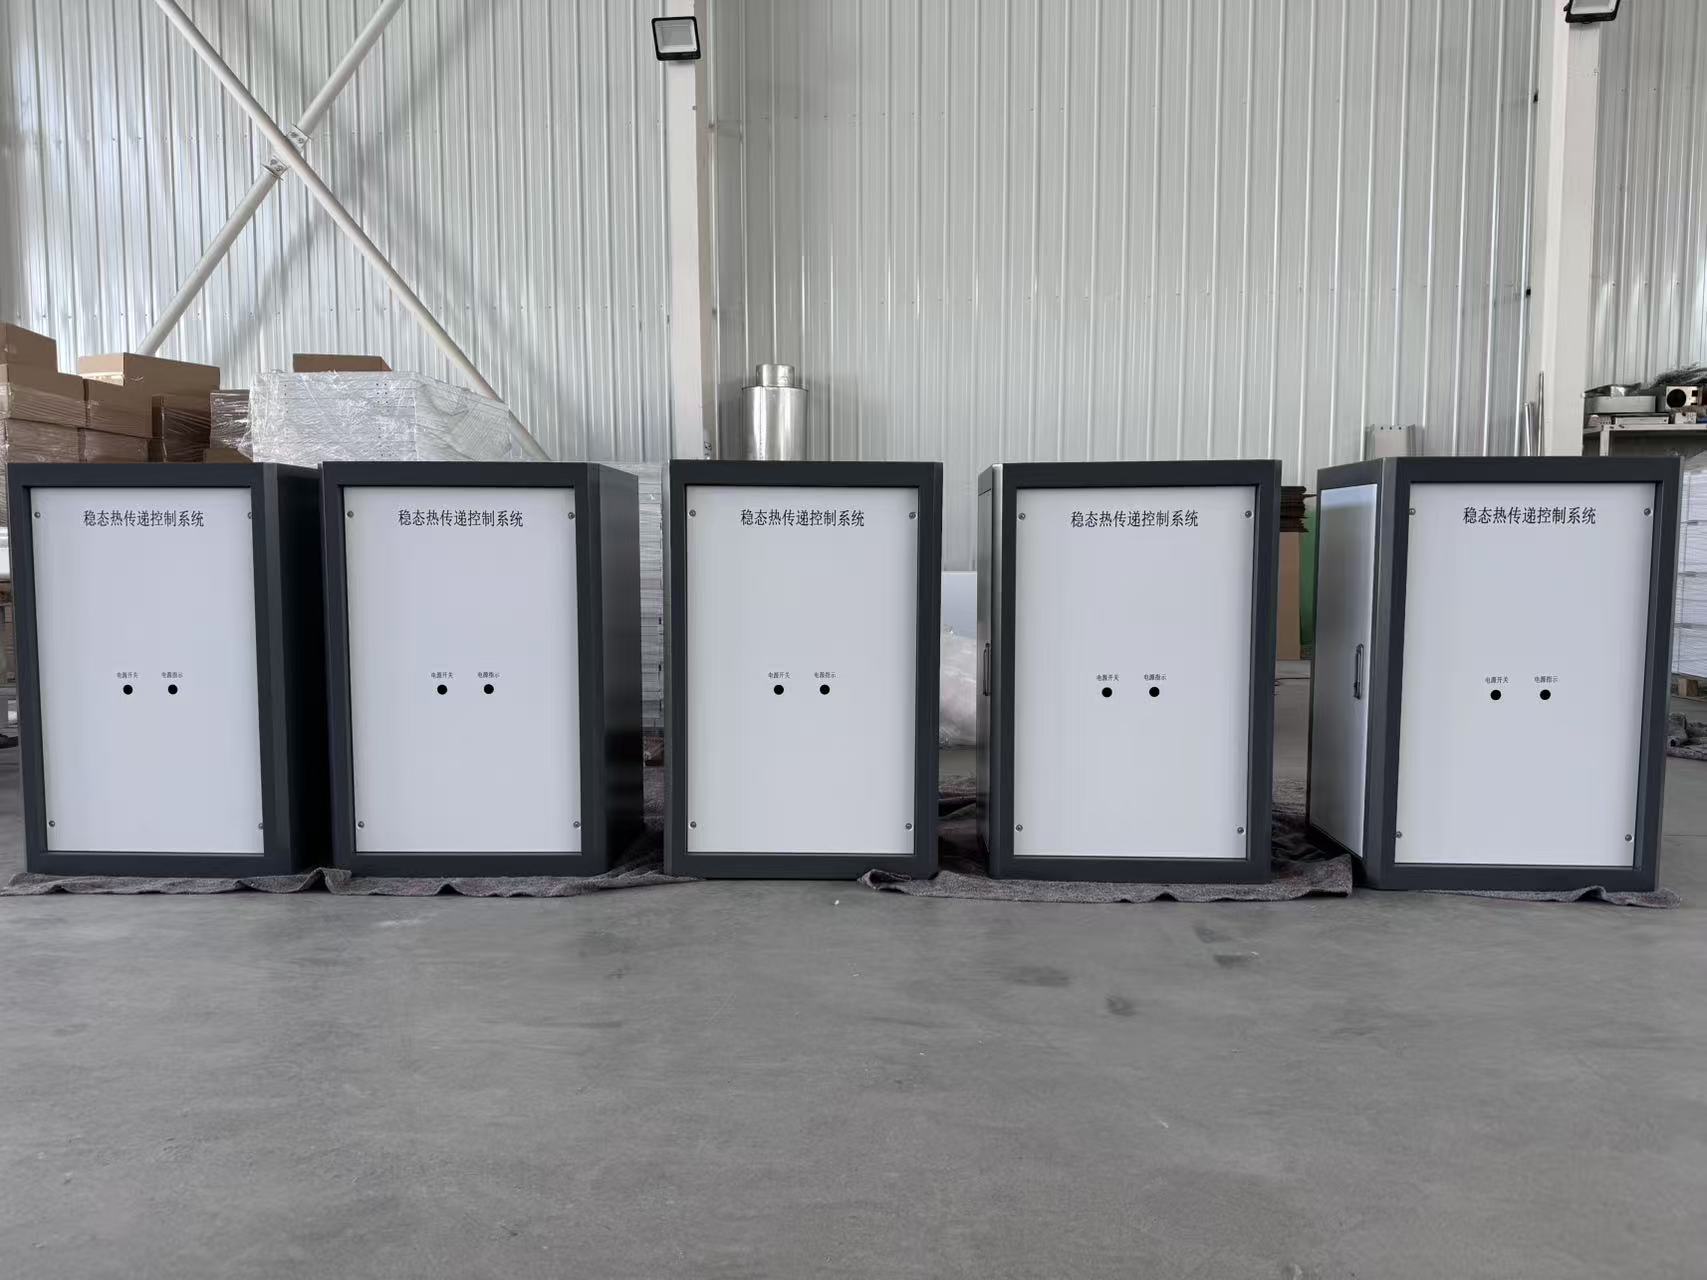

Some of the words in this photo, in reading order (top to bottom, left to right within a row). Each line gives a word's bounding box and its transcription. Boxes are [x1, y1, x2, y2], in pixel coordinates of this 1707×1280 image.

[82, 509, 204, 527] 稳态热传递控制系统
[398, 508, 523, 527] 稳态热传递控制系统
[741, 509, 865, 528] 稳态热传递控制系统
[1071, 509, 1199, 528] 稳态热传递控制系统
[1463, 506, 1597, 525] 稳态热传递控制系统
